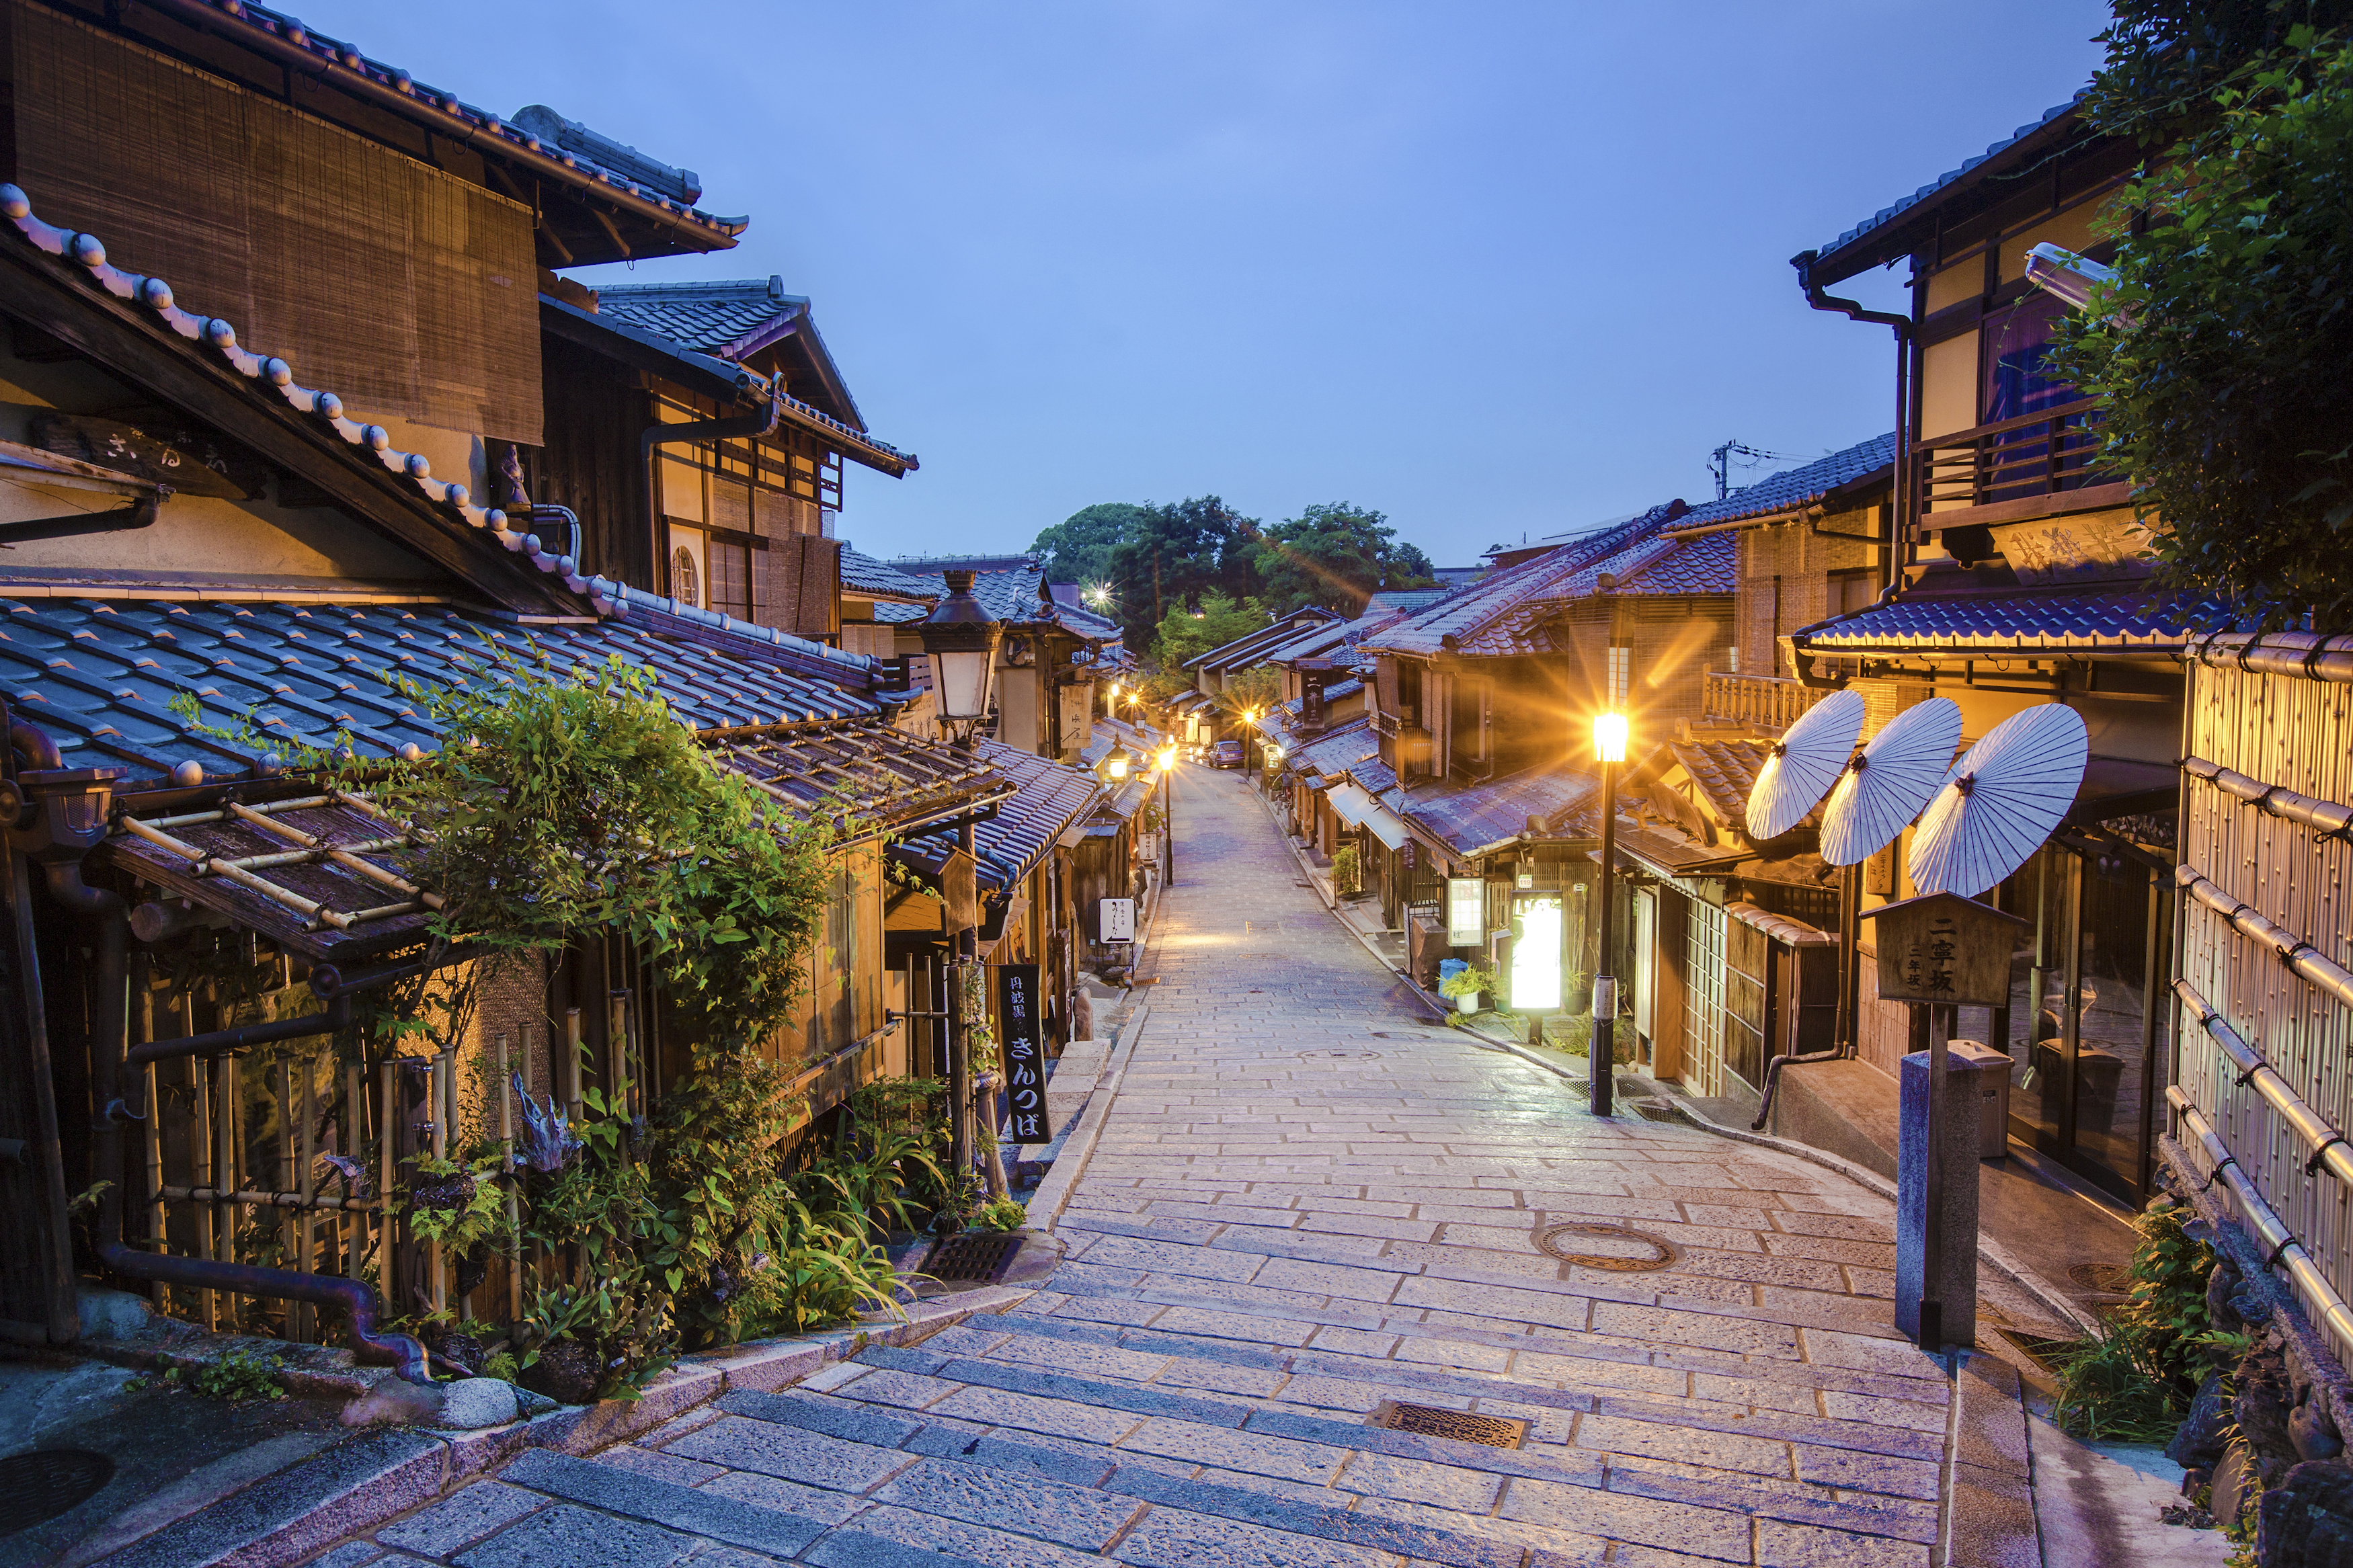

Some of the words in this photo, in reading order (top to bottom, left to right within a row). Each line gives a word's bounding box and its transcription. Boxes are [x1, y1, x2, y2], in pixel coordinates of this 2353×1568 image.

[1929, 917, 1957, 993] 二寧坂
[1010, 1036, 1039, 1137] きんつば
